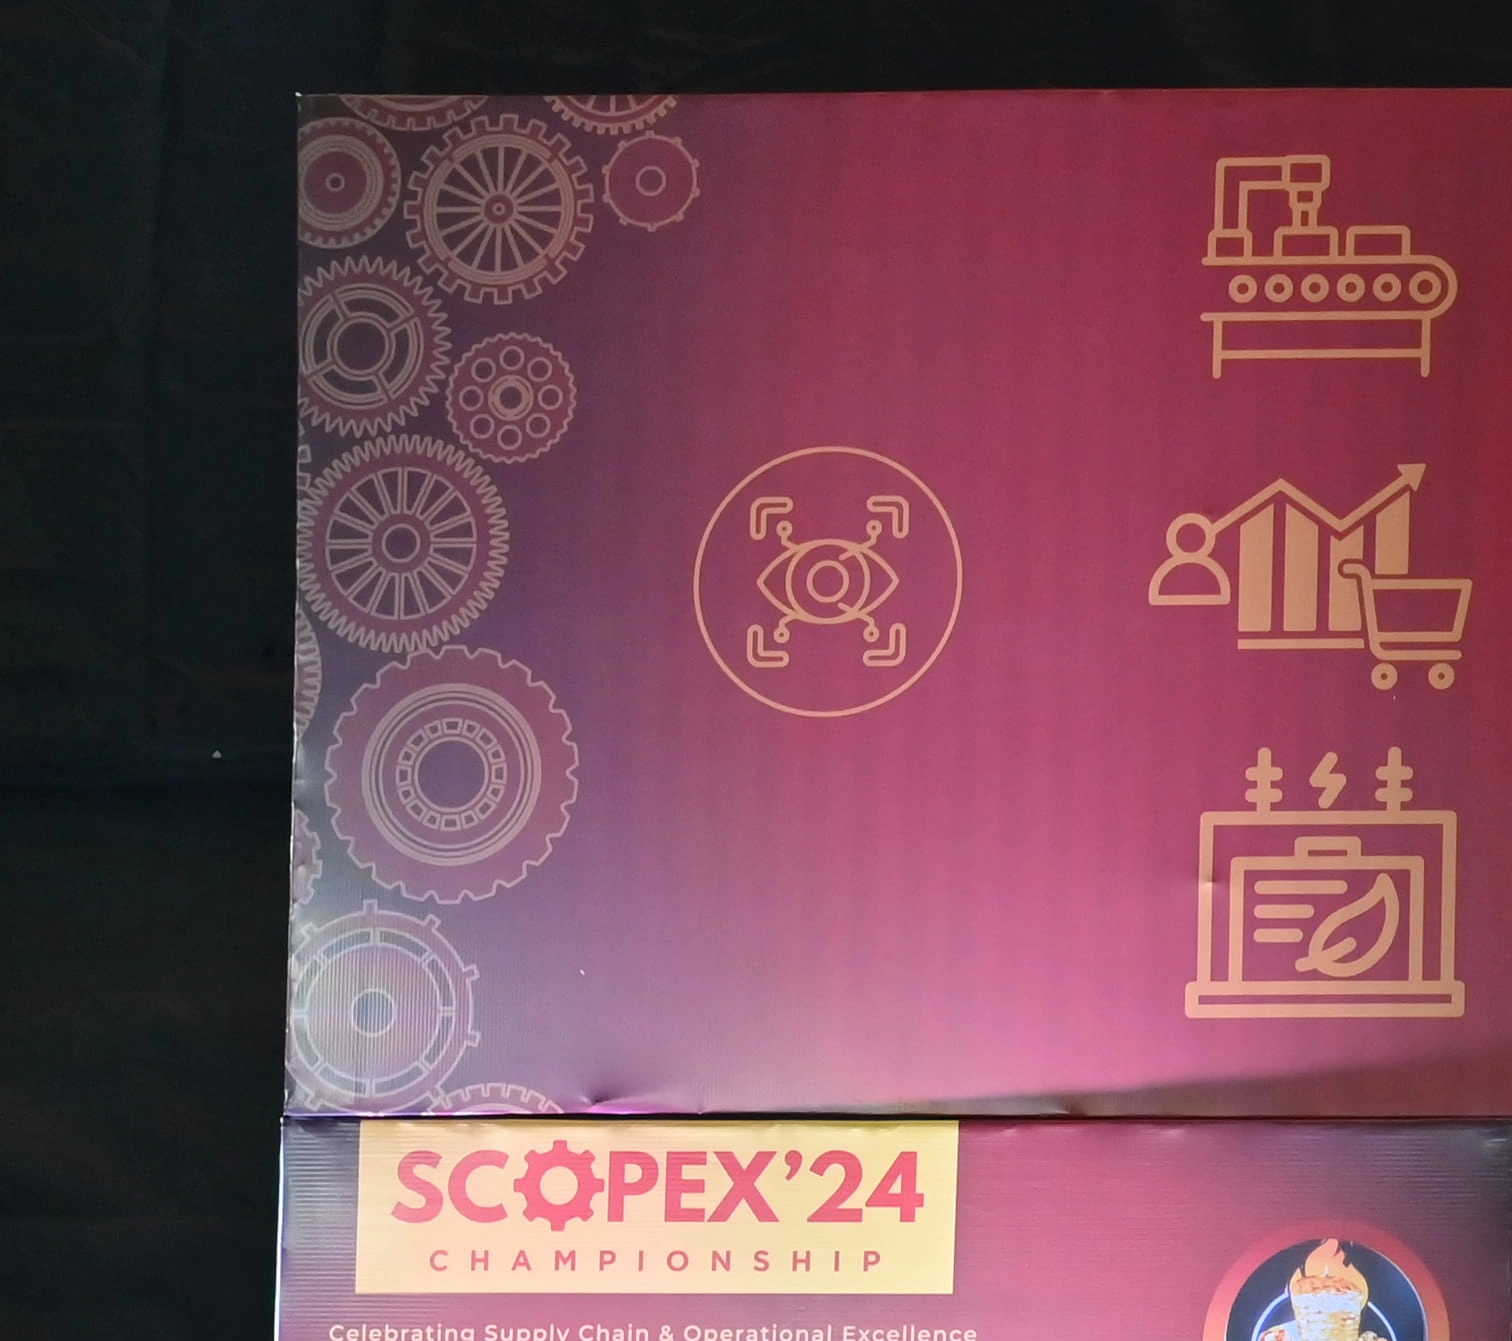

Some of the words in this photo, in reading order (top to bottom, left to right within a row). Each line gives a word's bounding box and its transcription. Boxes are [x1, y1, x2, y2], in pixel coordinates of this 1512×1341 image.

[430, 1250, 880, 1272] CHAMPIONSHIP
[579, 1324, 648, 1341] Chain
[659, 1325, 673, 1341] &
